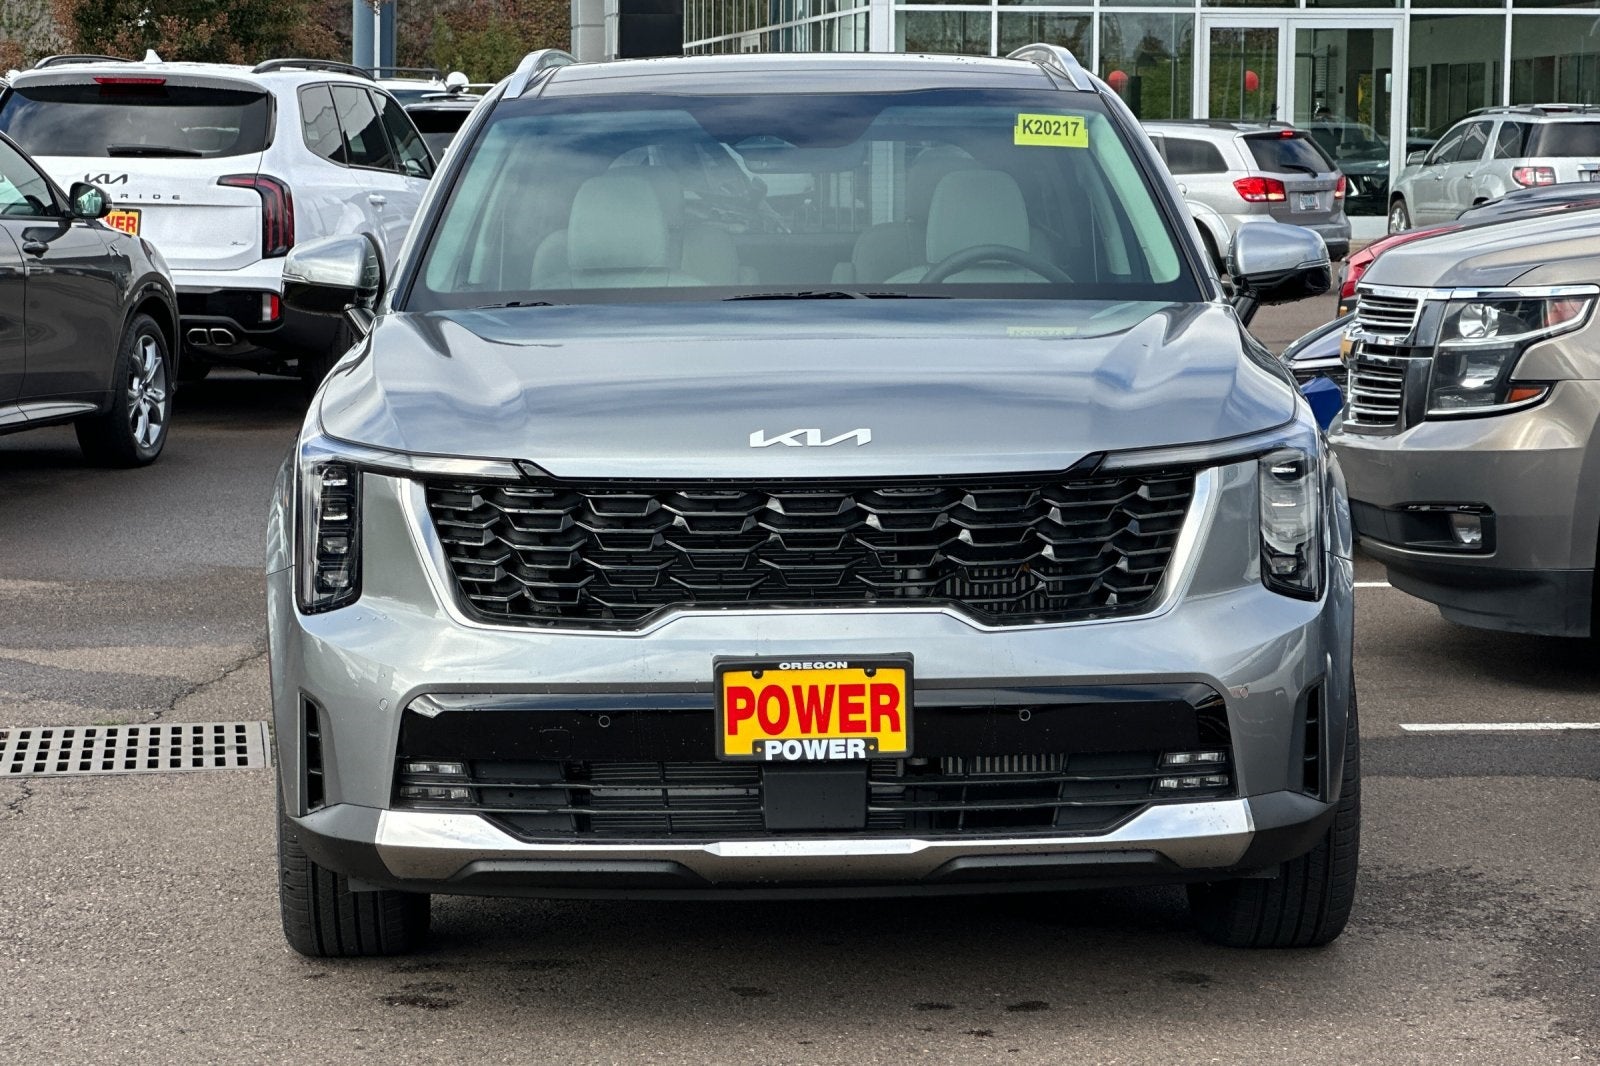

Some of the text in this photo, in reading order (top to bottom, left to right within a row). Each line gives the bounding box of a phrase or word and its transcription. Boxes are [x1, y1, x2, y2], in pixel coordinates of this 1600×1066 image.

[1022, 119, 1079, 136] K20217
[749, 428, 871, 448] KIA
[778, 661, 848, 670] OREGON
[726, 683, 901, 736] POWER
[764, 738, 866, 761] POWER
